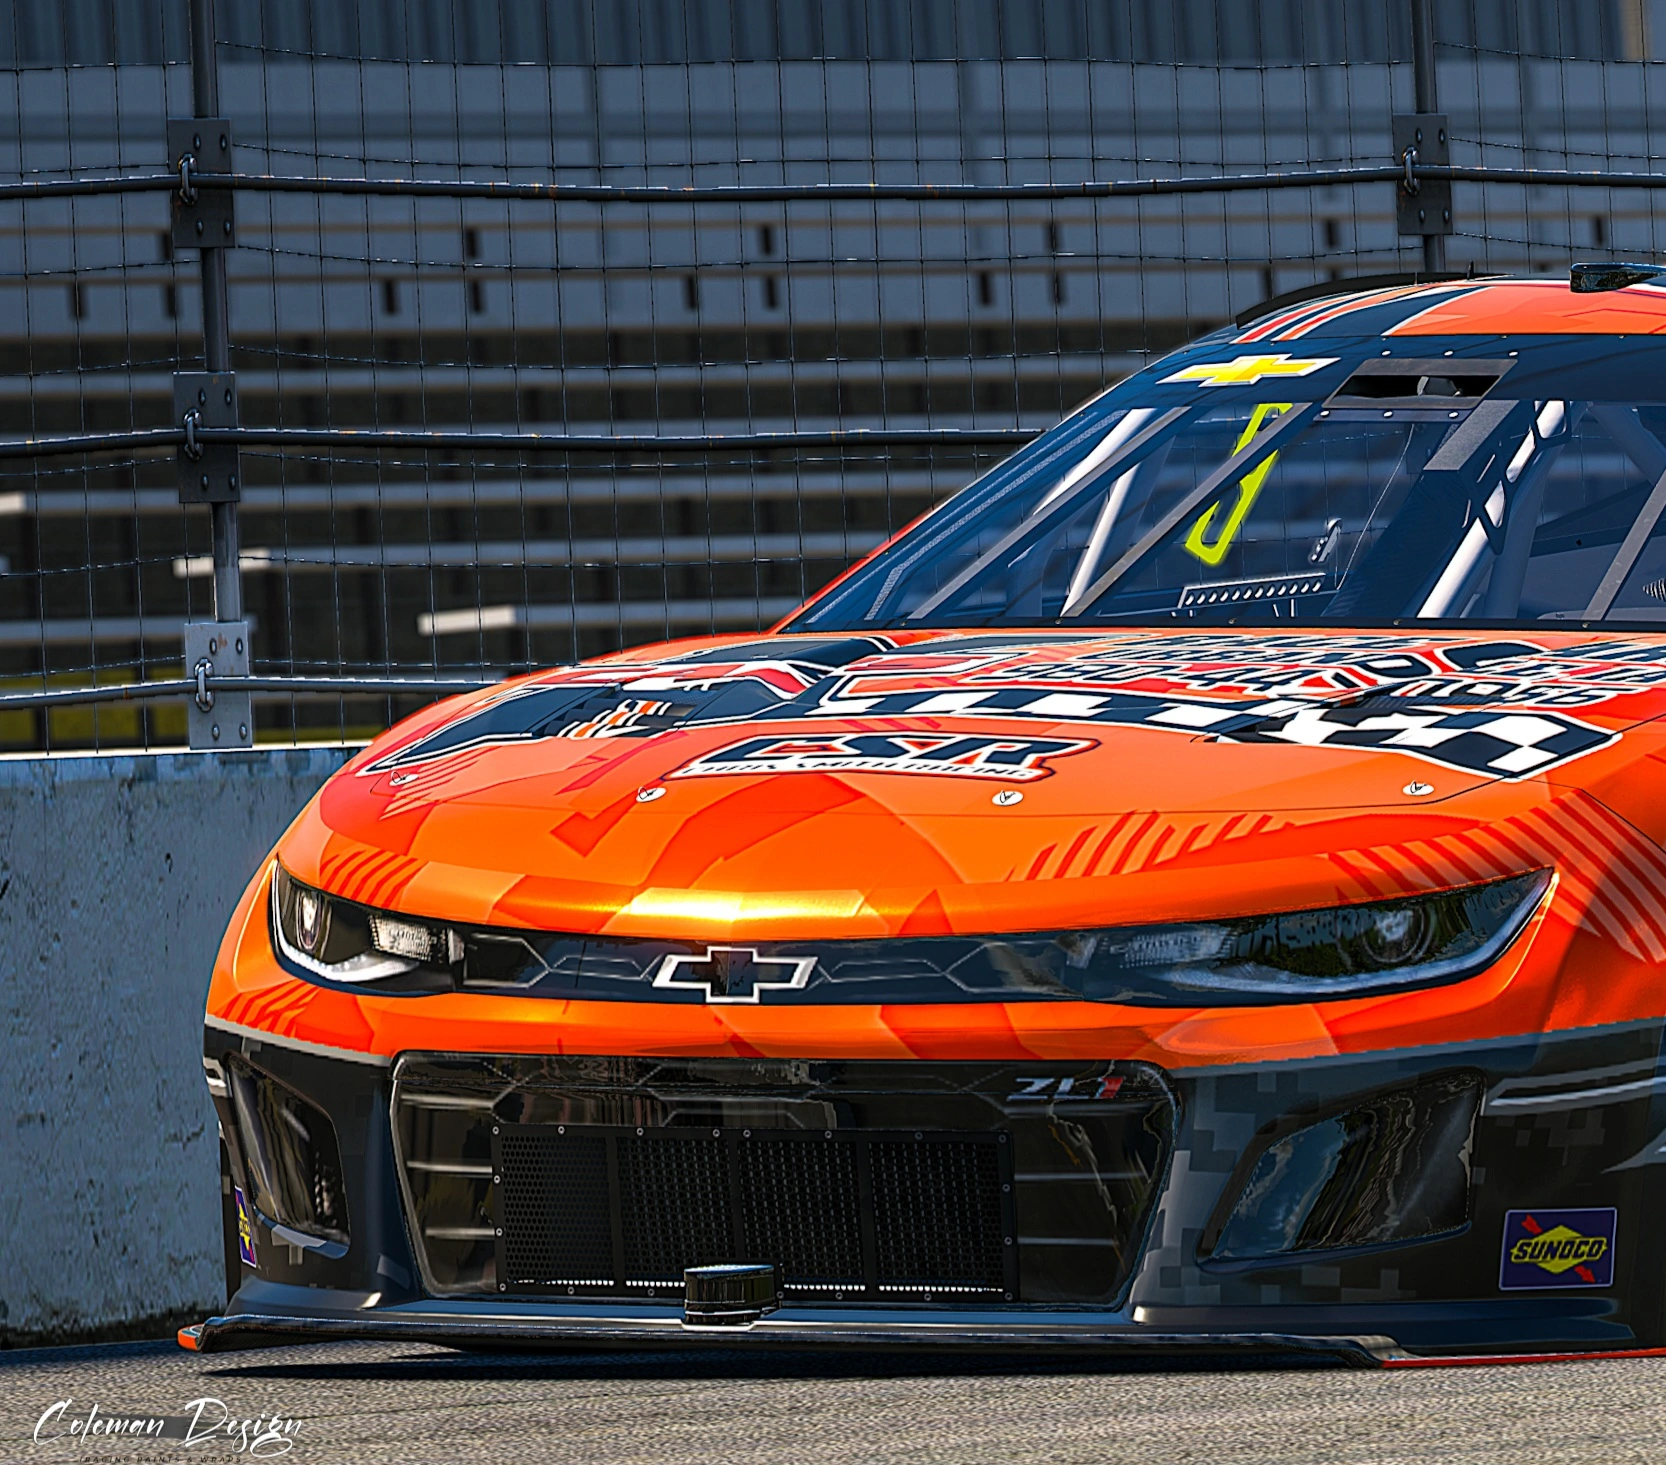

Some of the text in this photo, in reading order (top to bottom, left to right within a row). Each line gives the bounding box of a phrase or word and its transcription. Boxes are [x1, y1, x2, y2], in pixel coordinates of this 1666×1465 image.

[697, 733, 1082, 766] CSR
[1006, 1077, 1124, 1101] ZL1
[1511, 1238, 1607, 1262] SUNOCO
